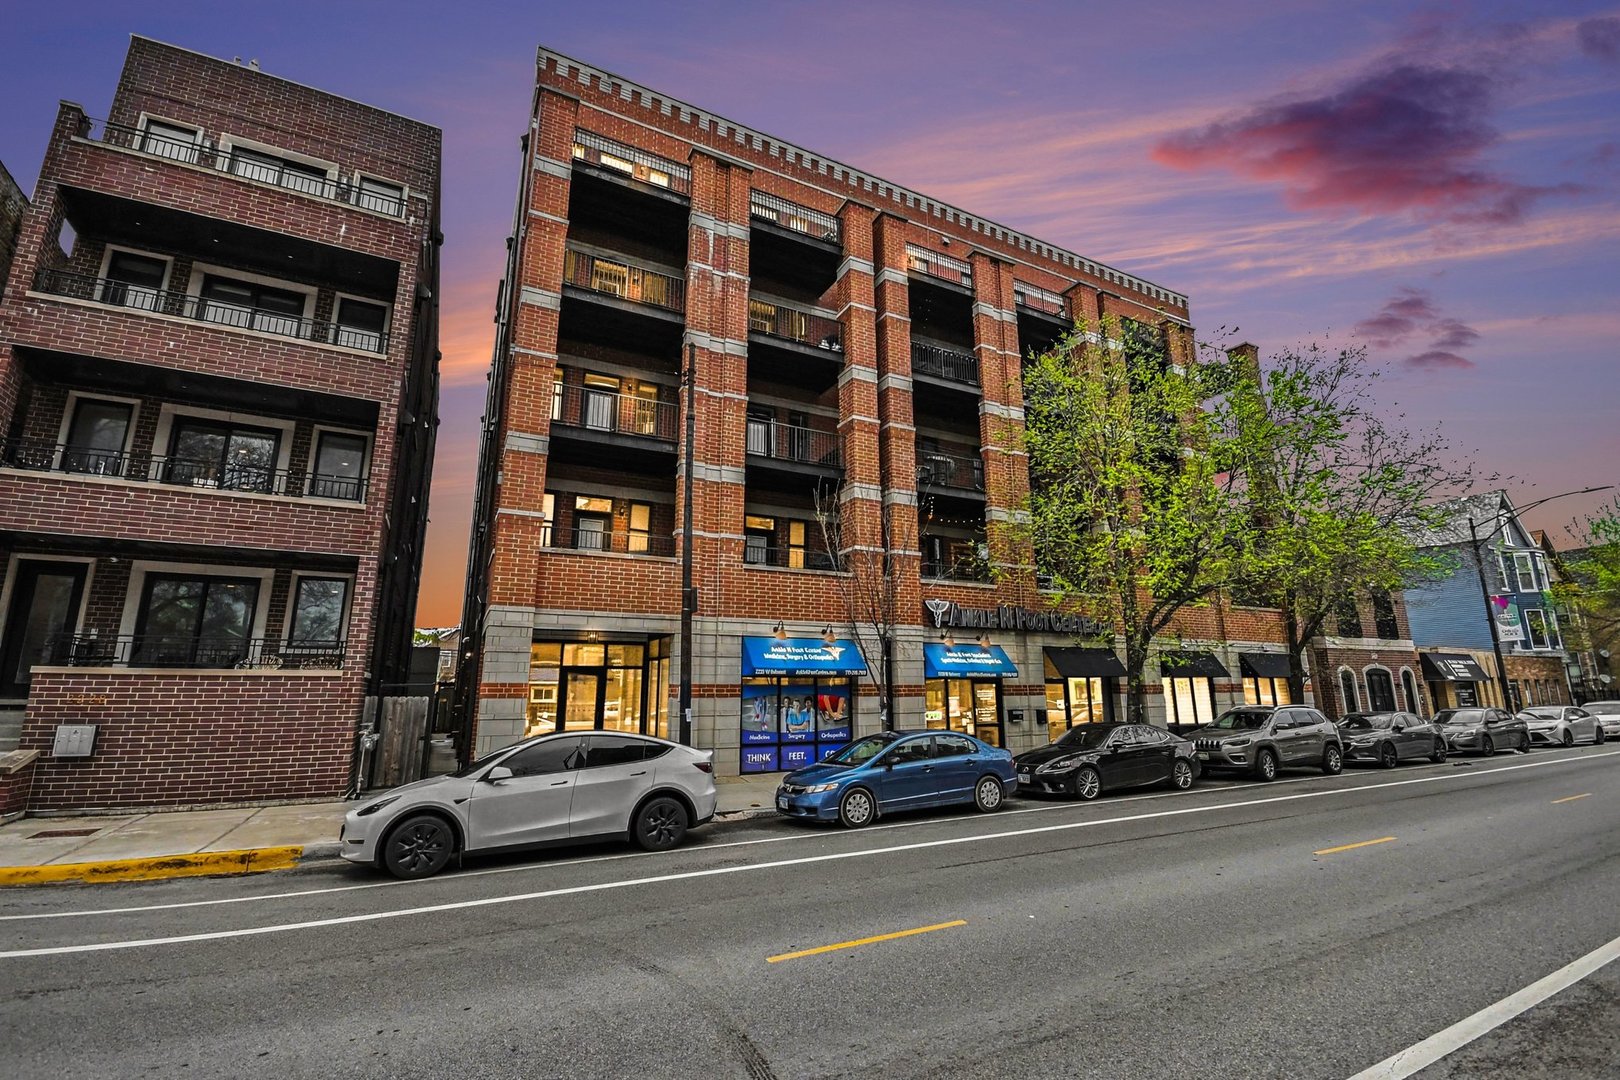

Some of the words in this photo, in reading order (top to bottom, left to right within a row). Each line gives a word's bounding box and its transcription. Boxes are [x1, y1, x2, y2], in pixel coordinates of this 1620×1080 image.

[1014, 606, 1050, 632] FOOT
[1051, 609, 1114, 635] CENTE
[747, 753, 771, 763] THINK
[788, 751, 807, 761] FEET.
